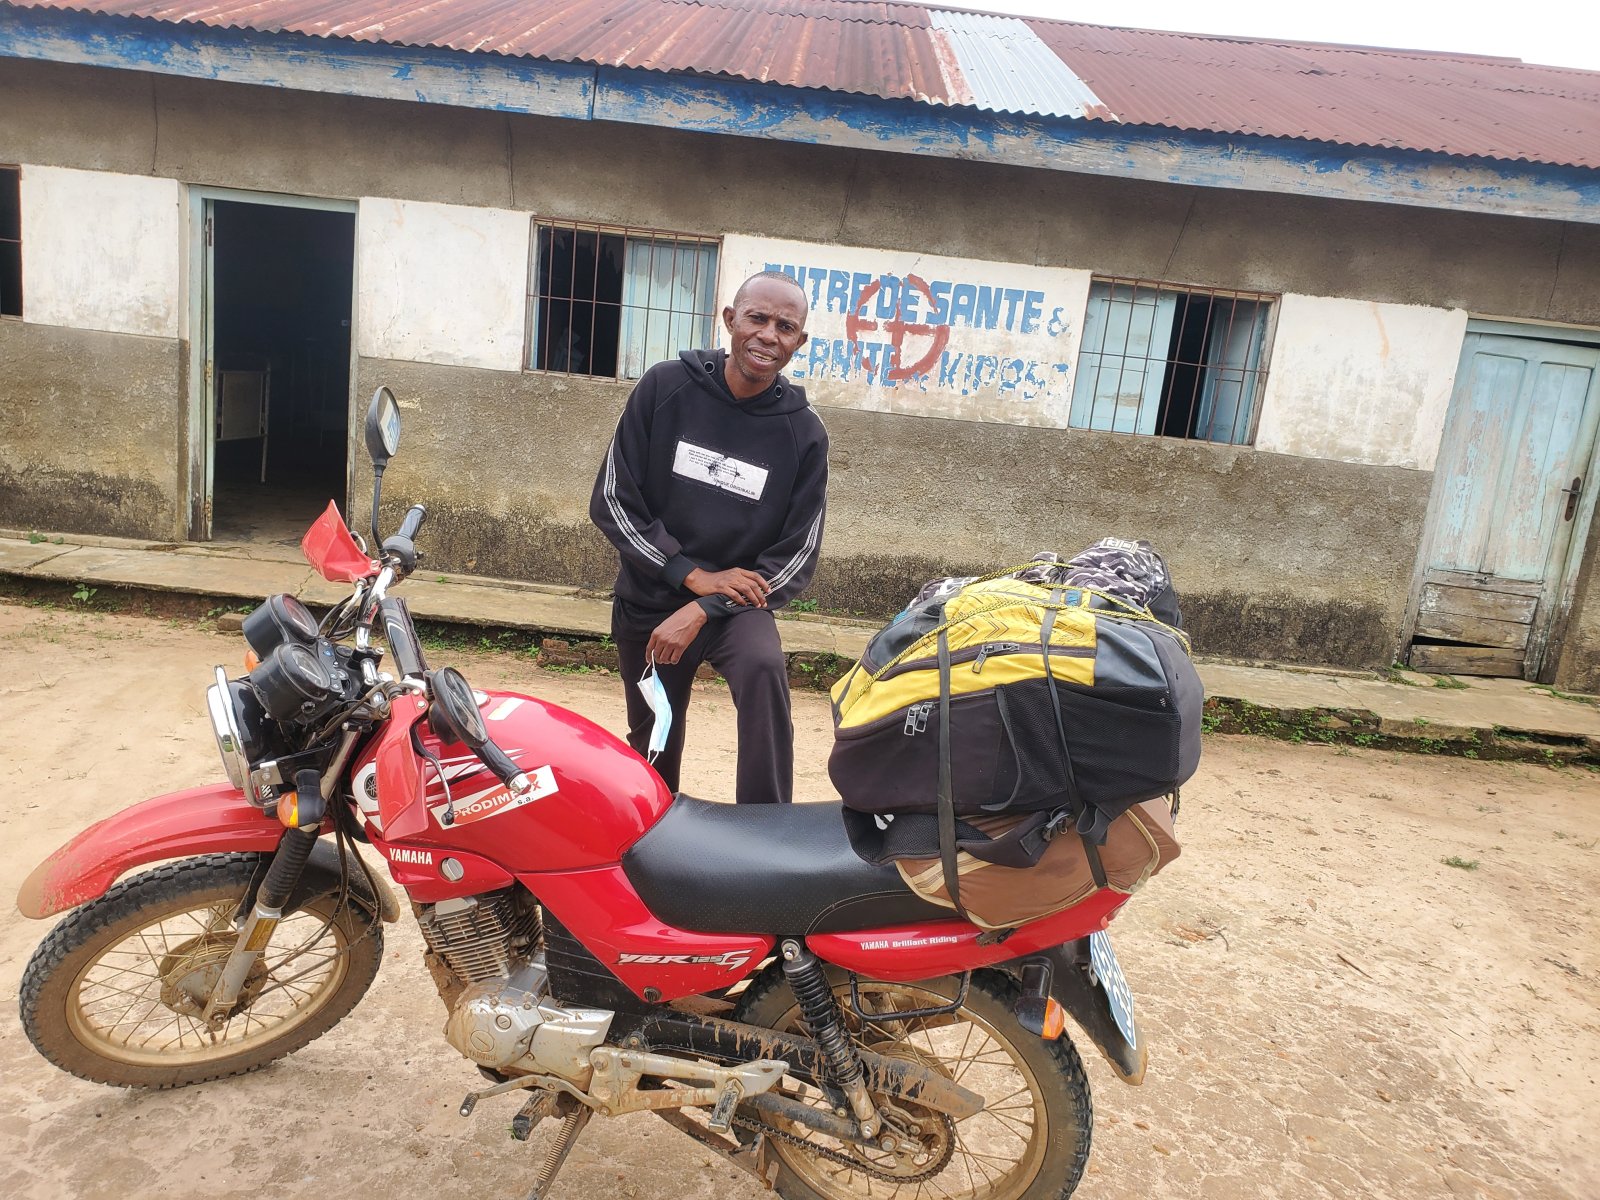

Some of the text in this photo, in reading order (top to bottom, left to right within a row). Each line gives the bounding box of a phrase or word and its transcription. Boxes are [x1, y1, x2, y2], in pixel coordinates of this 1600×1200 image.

[876, 274, 920, 323] DE
[925, 280, 1045, 335] SANTE
[389, 847, 433, 865] YAMAHA
[860, 935, 958, 951] YAMAHA Brilliant Riding
